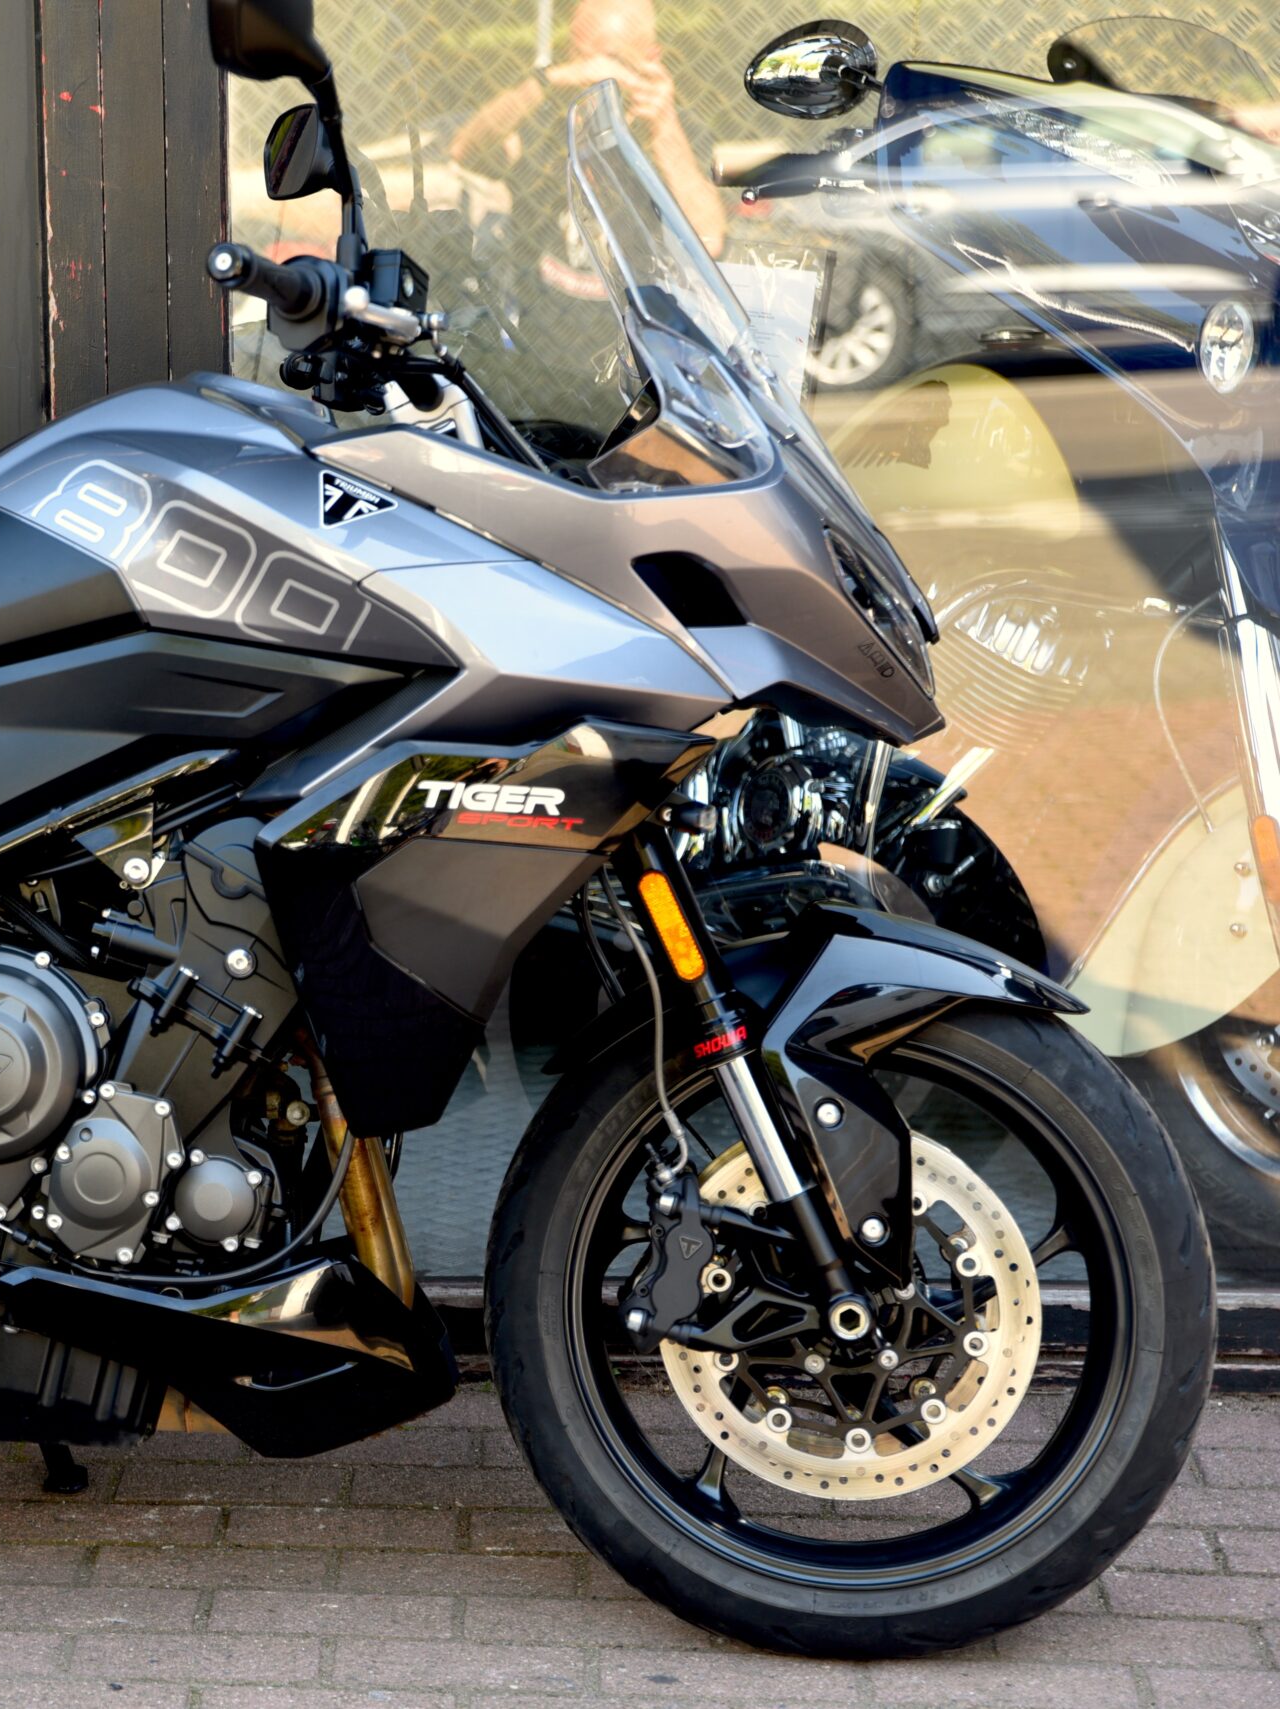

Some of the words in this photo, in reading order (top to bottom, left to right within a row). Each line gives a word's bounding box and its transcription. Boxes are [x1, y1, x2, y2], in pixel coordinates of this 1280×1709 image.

[335, 478, 380, 503] TRIUMPH
[31, 459, 371, 651] 800
[418, 780, 565, 816] TIGER
[457, 812, 585, 831] SPORT
[694, 1025, 747, 1058] SHOWA
